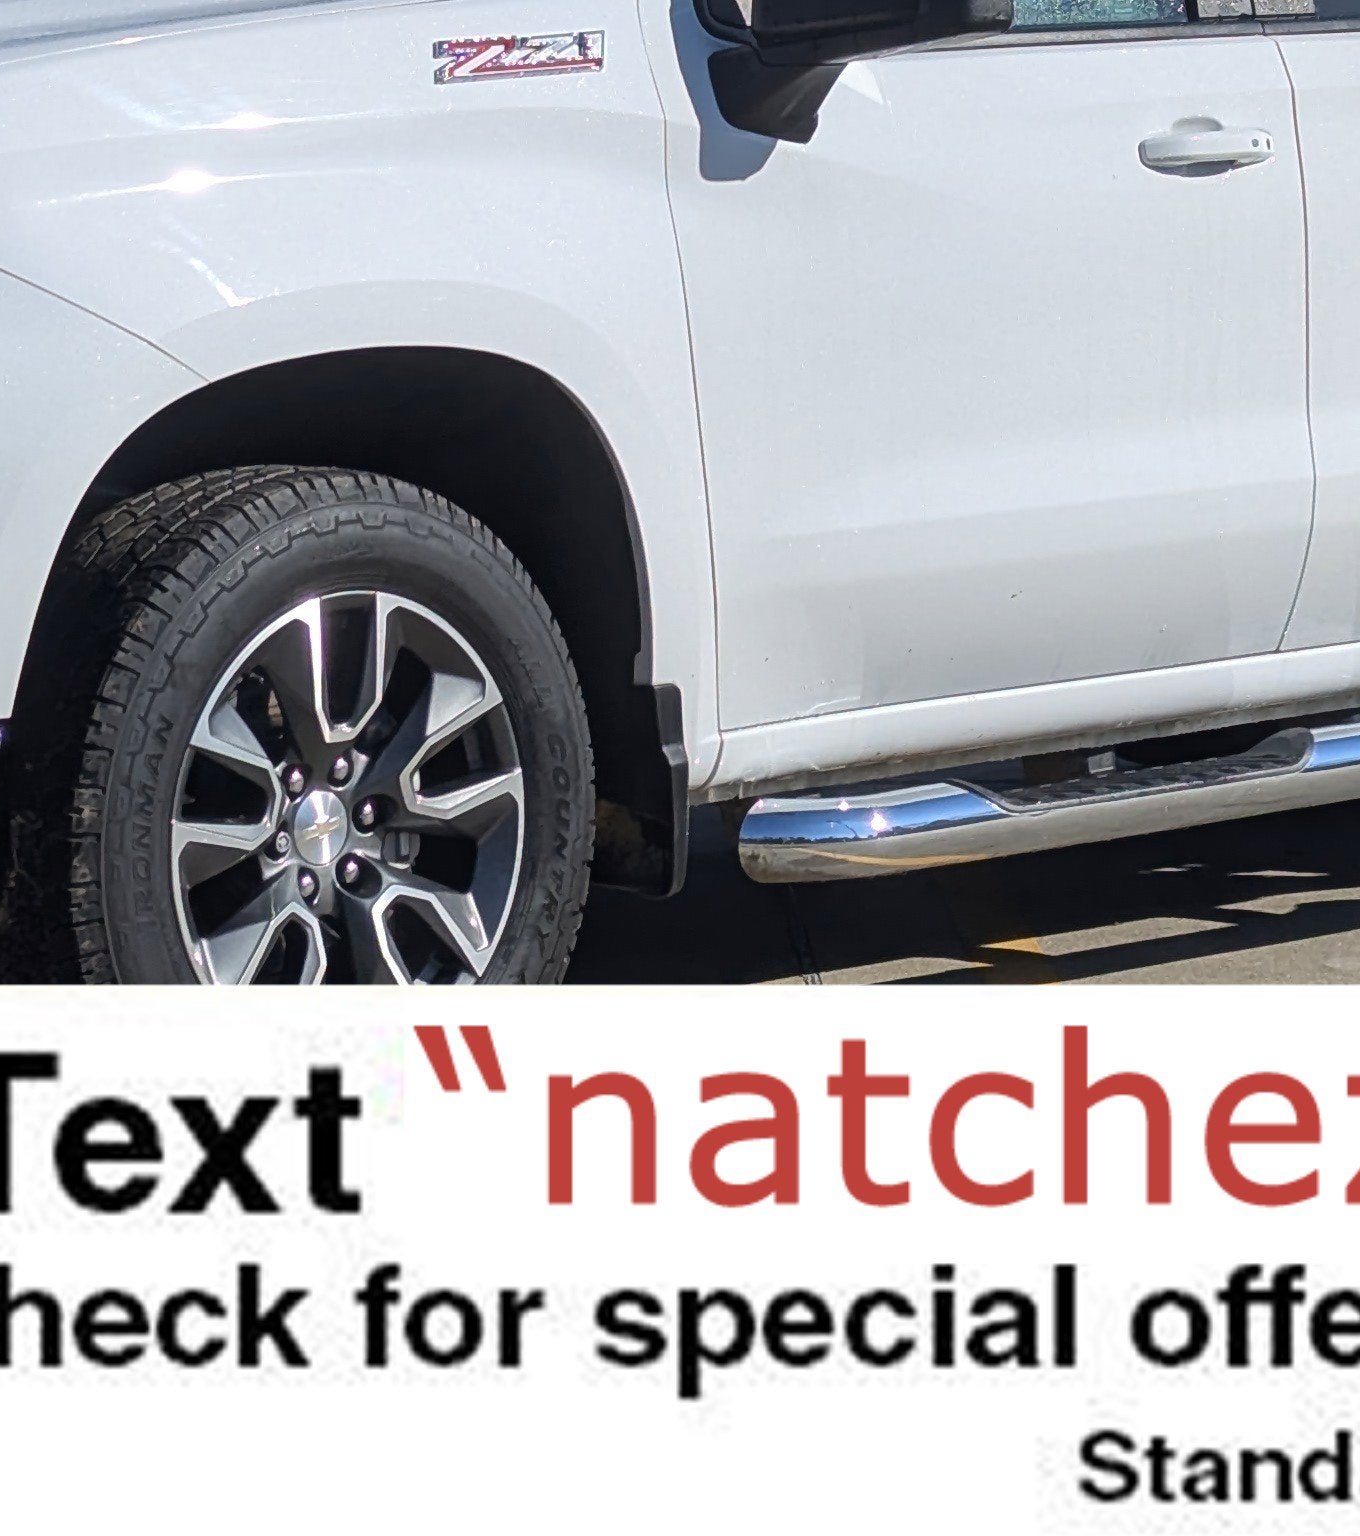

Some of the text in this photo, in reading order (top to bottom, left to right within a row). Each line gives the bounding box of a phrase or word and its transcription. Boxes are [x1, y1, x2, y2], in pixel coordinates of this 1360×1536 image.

[433, 30, 605, 84] Z71
[130, 712, 175, 930] IRONMAN
[534, 732, 573, 959] COUNTRY
